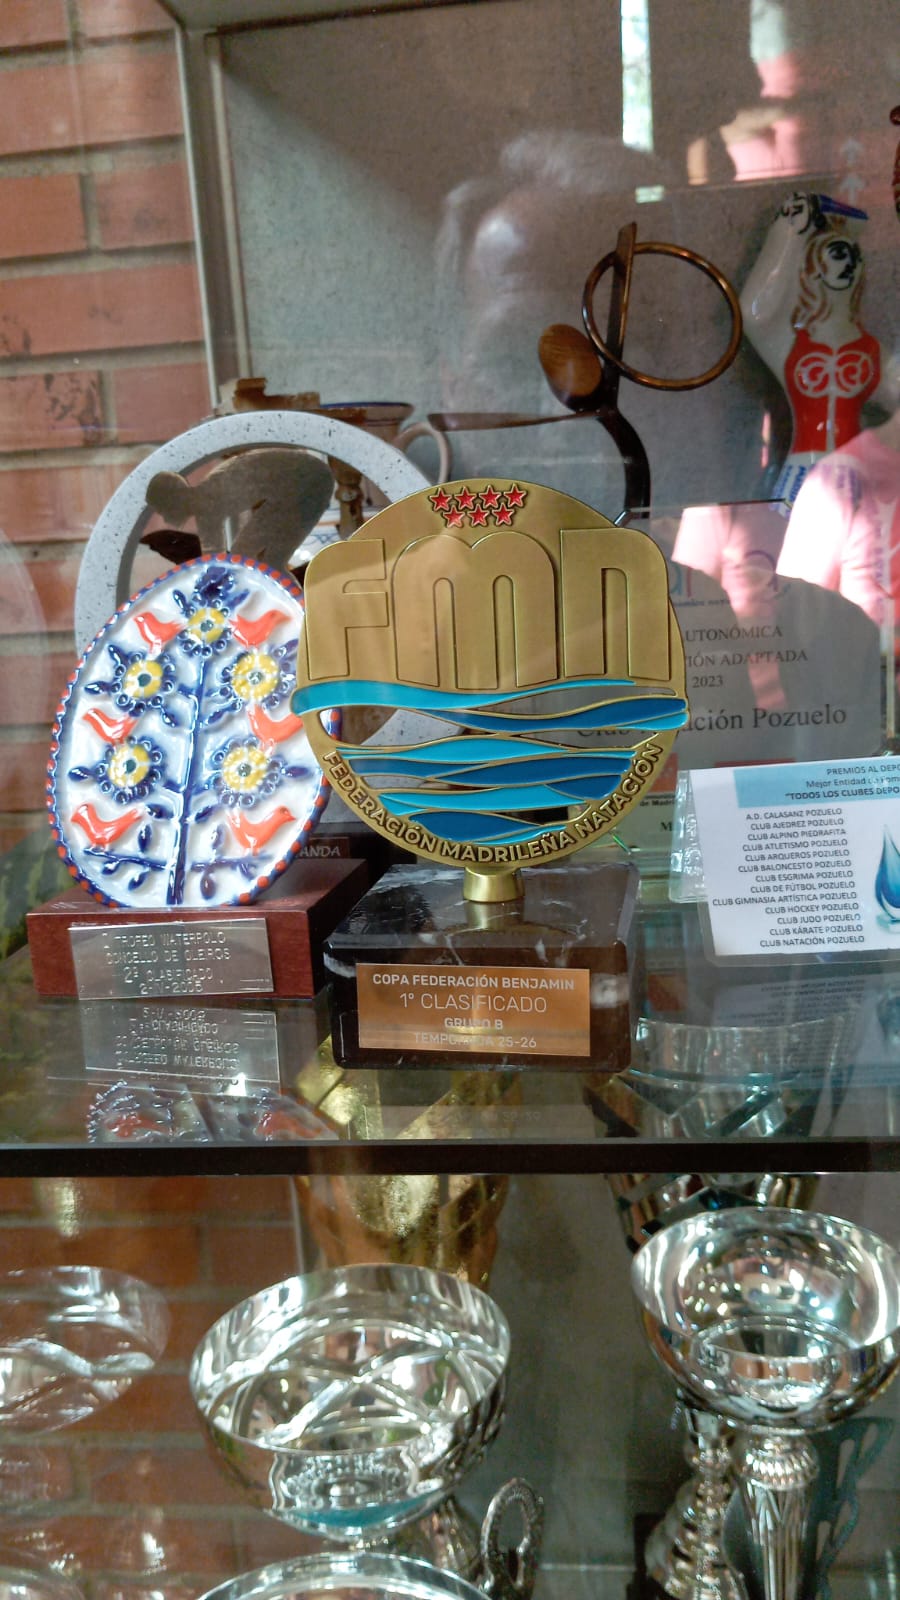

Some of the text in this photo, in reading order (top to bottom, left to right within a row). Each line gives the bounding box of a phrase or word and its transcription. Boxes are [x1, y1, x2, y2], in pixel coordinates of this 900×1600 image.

[685, 624, 784, 642] UTONÓMICA
[721, 650, 808, 666] ADAPTADA
[692, 675, 723, 688] 2023
[753, 703, 847, 729] Pozuelo
[826, 766, 866, 775] PREMIOS
[868, 765, 878, 773] AL
[806, 780, 831, 789] Mejor
[834, 777, 866, 786] Entidad
[823, 790, 839, 798] LOS
[841, 788, 874, 797] CLUBES
[322, 742, 664, 864] FEDERACIÓN MADRILEÑA NATACIÓN
[746, 808, 842, 821] A.D. CALASANZ POZUELO
[750, 818, 844, 831] CLUB AJEDREZ POZUELO
[747, 829, 846, 841] CLUB ALPINO PIEDRAFITA
[300, 845, 341, 857] ANDA
[742, 839, 848, 852] CLUB ATLETISMO POZUELO
[745, 849, 850, 862] CLUB ARQUEROS POZUELO
[738, 859, 852, 873] CLUB BALONCESTO POZUELO
[755, 870, 854, 883] CLUB ESGRIMA POZUELO
[750, 886, 771, 894] CLUB
[785, 882, 816, 891] FÚTBOL
[818, 881, 856, 890] POZUELO
[712, 892, 857, 906] CLUB GIMNASIA ARTÍSTICA POZUELO
[787, 904, 820, 913] HOCKEY
[822, 902, 859, 911] POZUELO
[777, 913, 861, 925] CLUB JUDO POZUELO
[769, 924, 863, 936] CLUB KÁRATE POZUELO
[759, 935, 865, 948] CLUB NATACIÓN POZUELO
[372, 973, 575, 990] COPA FEDERACIÓN BENJAMIN
[421, 993, 547, 1013] CLASIFICADO
[444, 1017, 504, 1030] GRUPO B
[499, 1036, 537, 1048] 25-26
